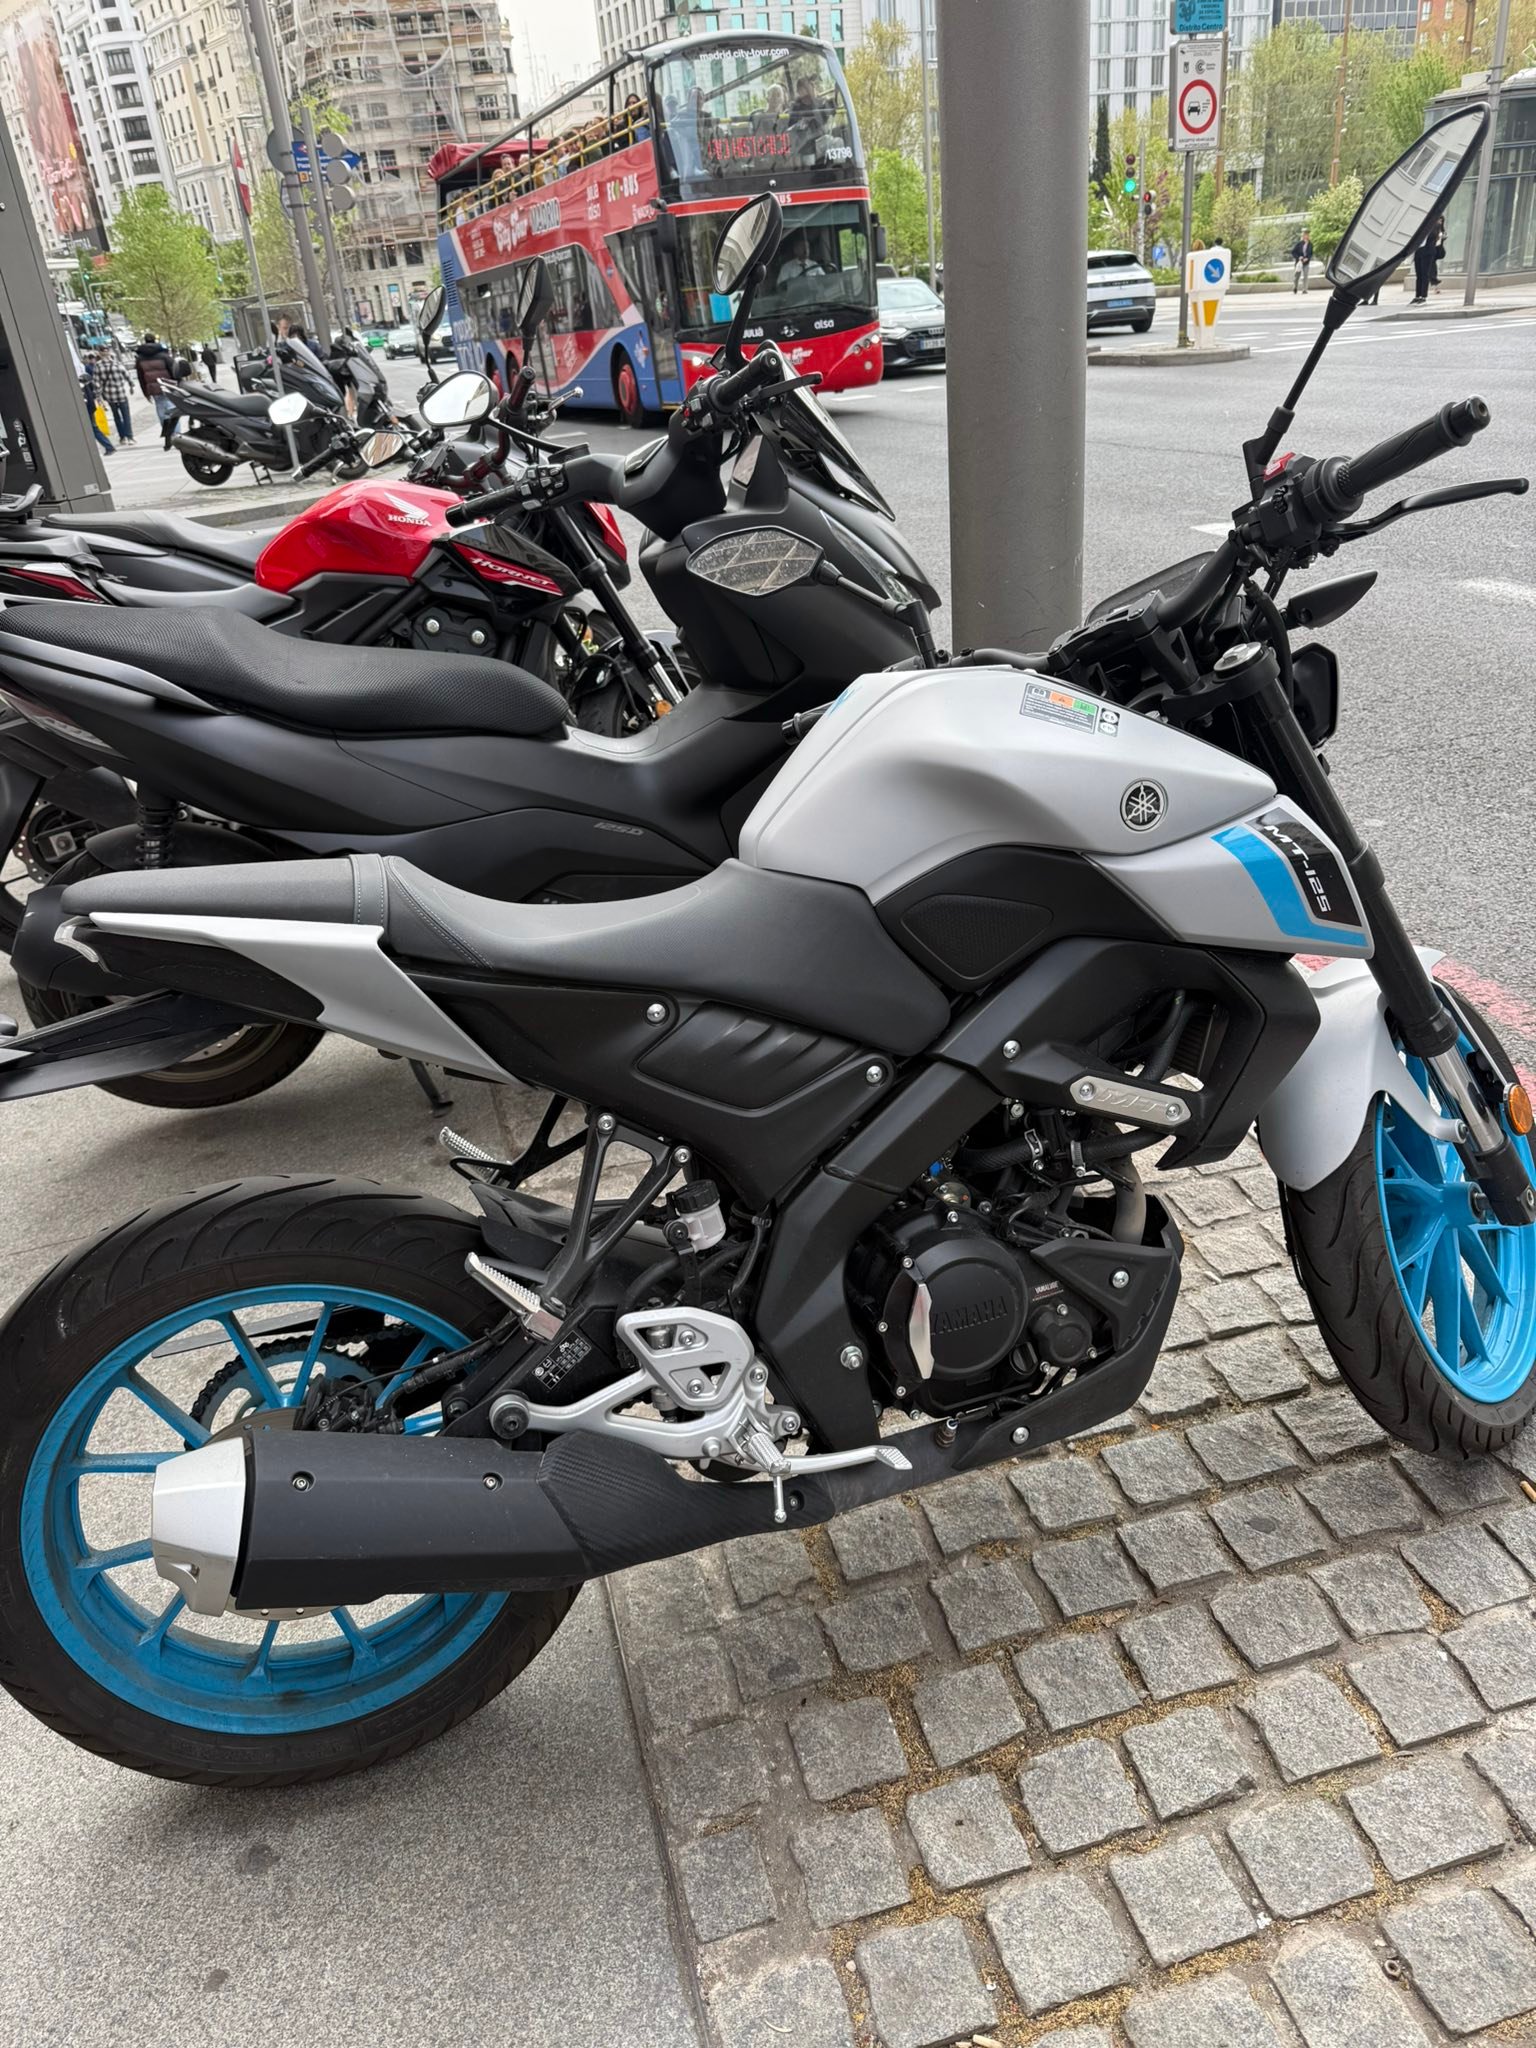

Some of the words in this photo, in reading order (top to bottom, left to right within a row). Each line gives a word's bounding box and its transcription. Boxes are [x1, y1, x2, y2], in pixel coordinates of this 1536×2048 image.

[1179, 22, 1201, 32] Distrito
[1201, 22, 1223, 31] Centro
[699, 47, 790, 61] madrid.city-tour.com
[814, 318, 835, 330] alsa
[387, 514, 433, 527] HONDA
[1263, 825, 1332, 913] MT-125
